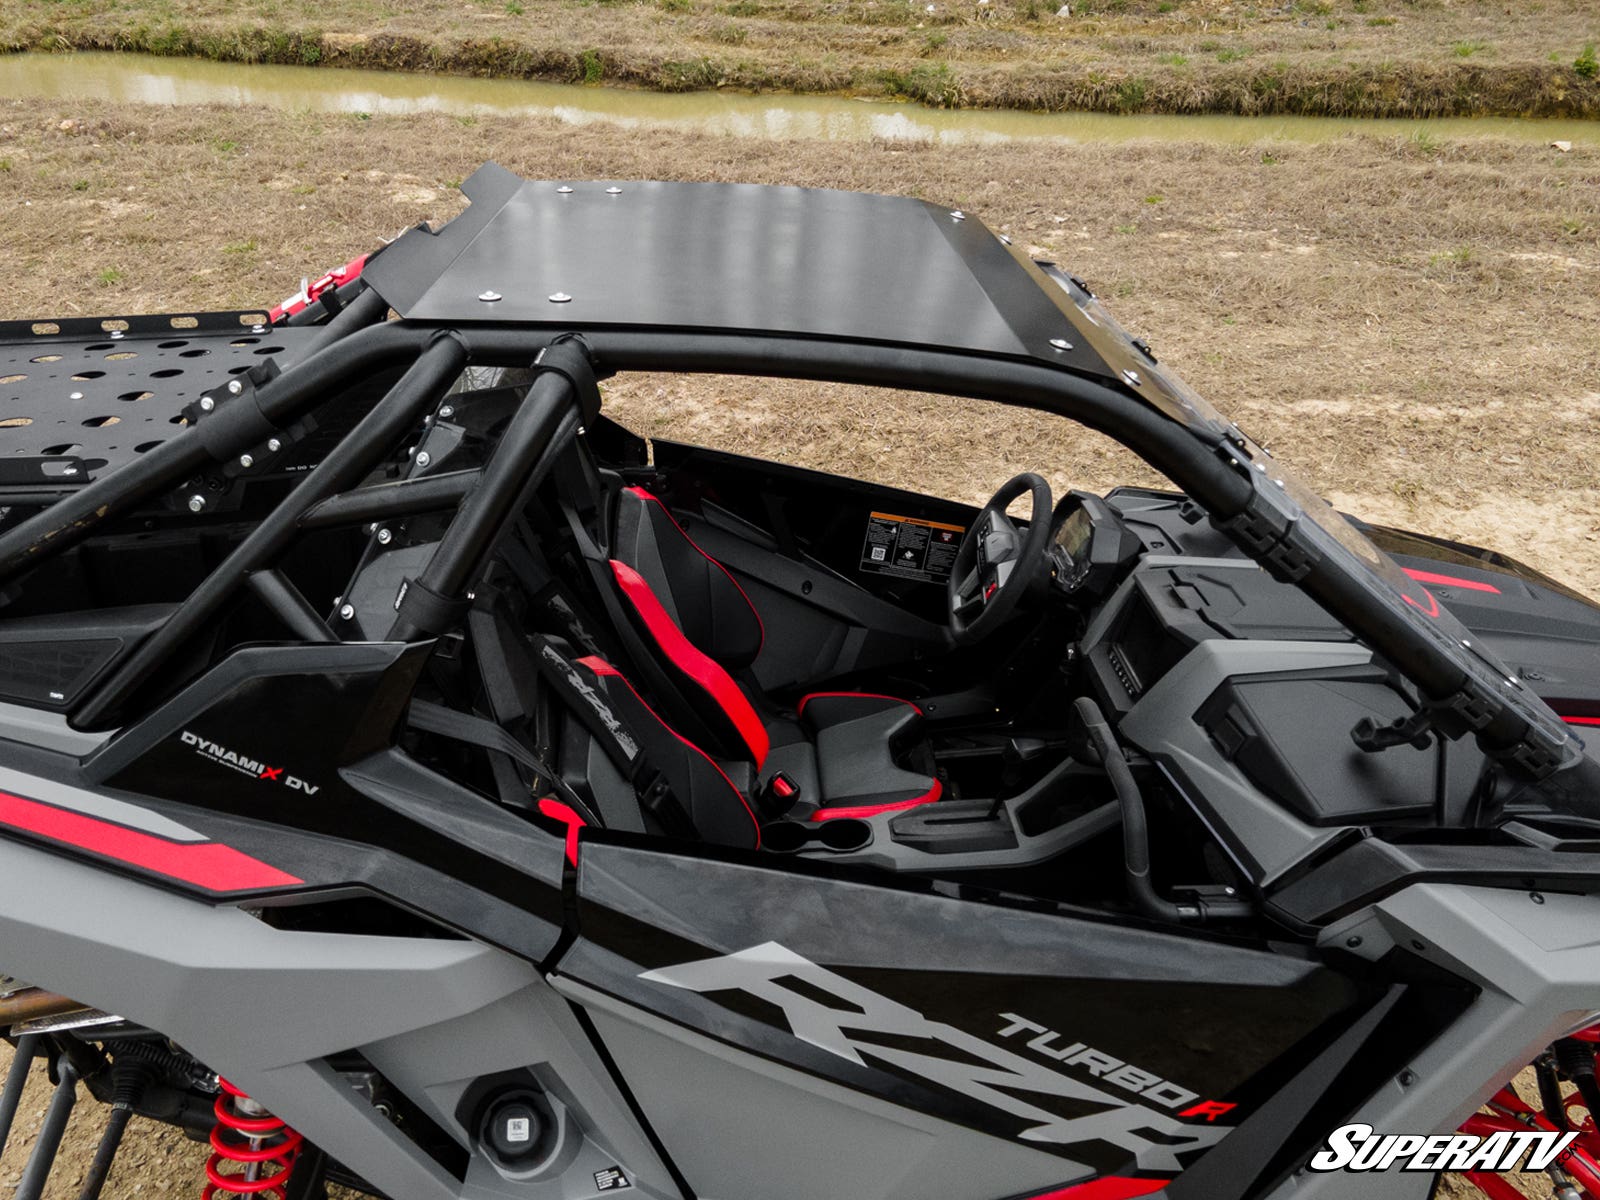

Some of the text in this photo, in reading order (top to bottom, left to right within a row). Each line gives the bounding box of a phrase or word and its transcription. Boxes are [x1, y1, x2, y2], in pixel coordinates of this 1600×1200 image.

[180, 731, 320, 796] DYNAMIX DV
[637, 941, 1237, 1171] RZR
